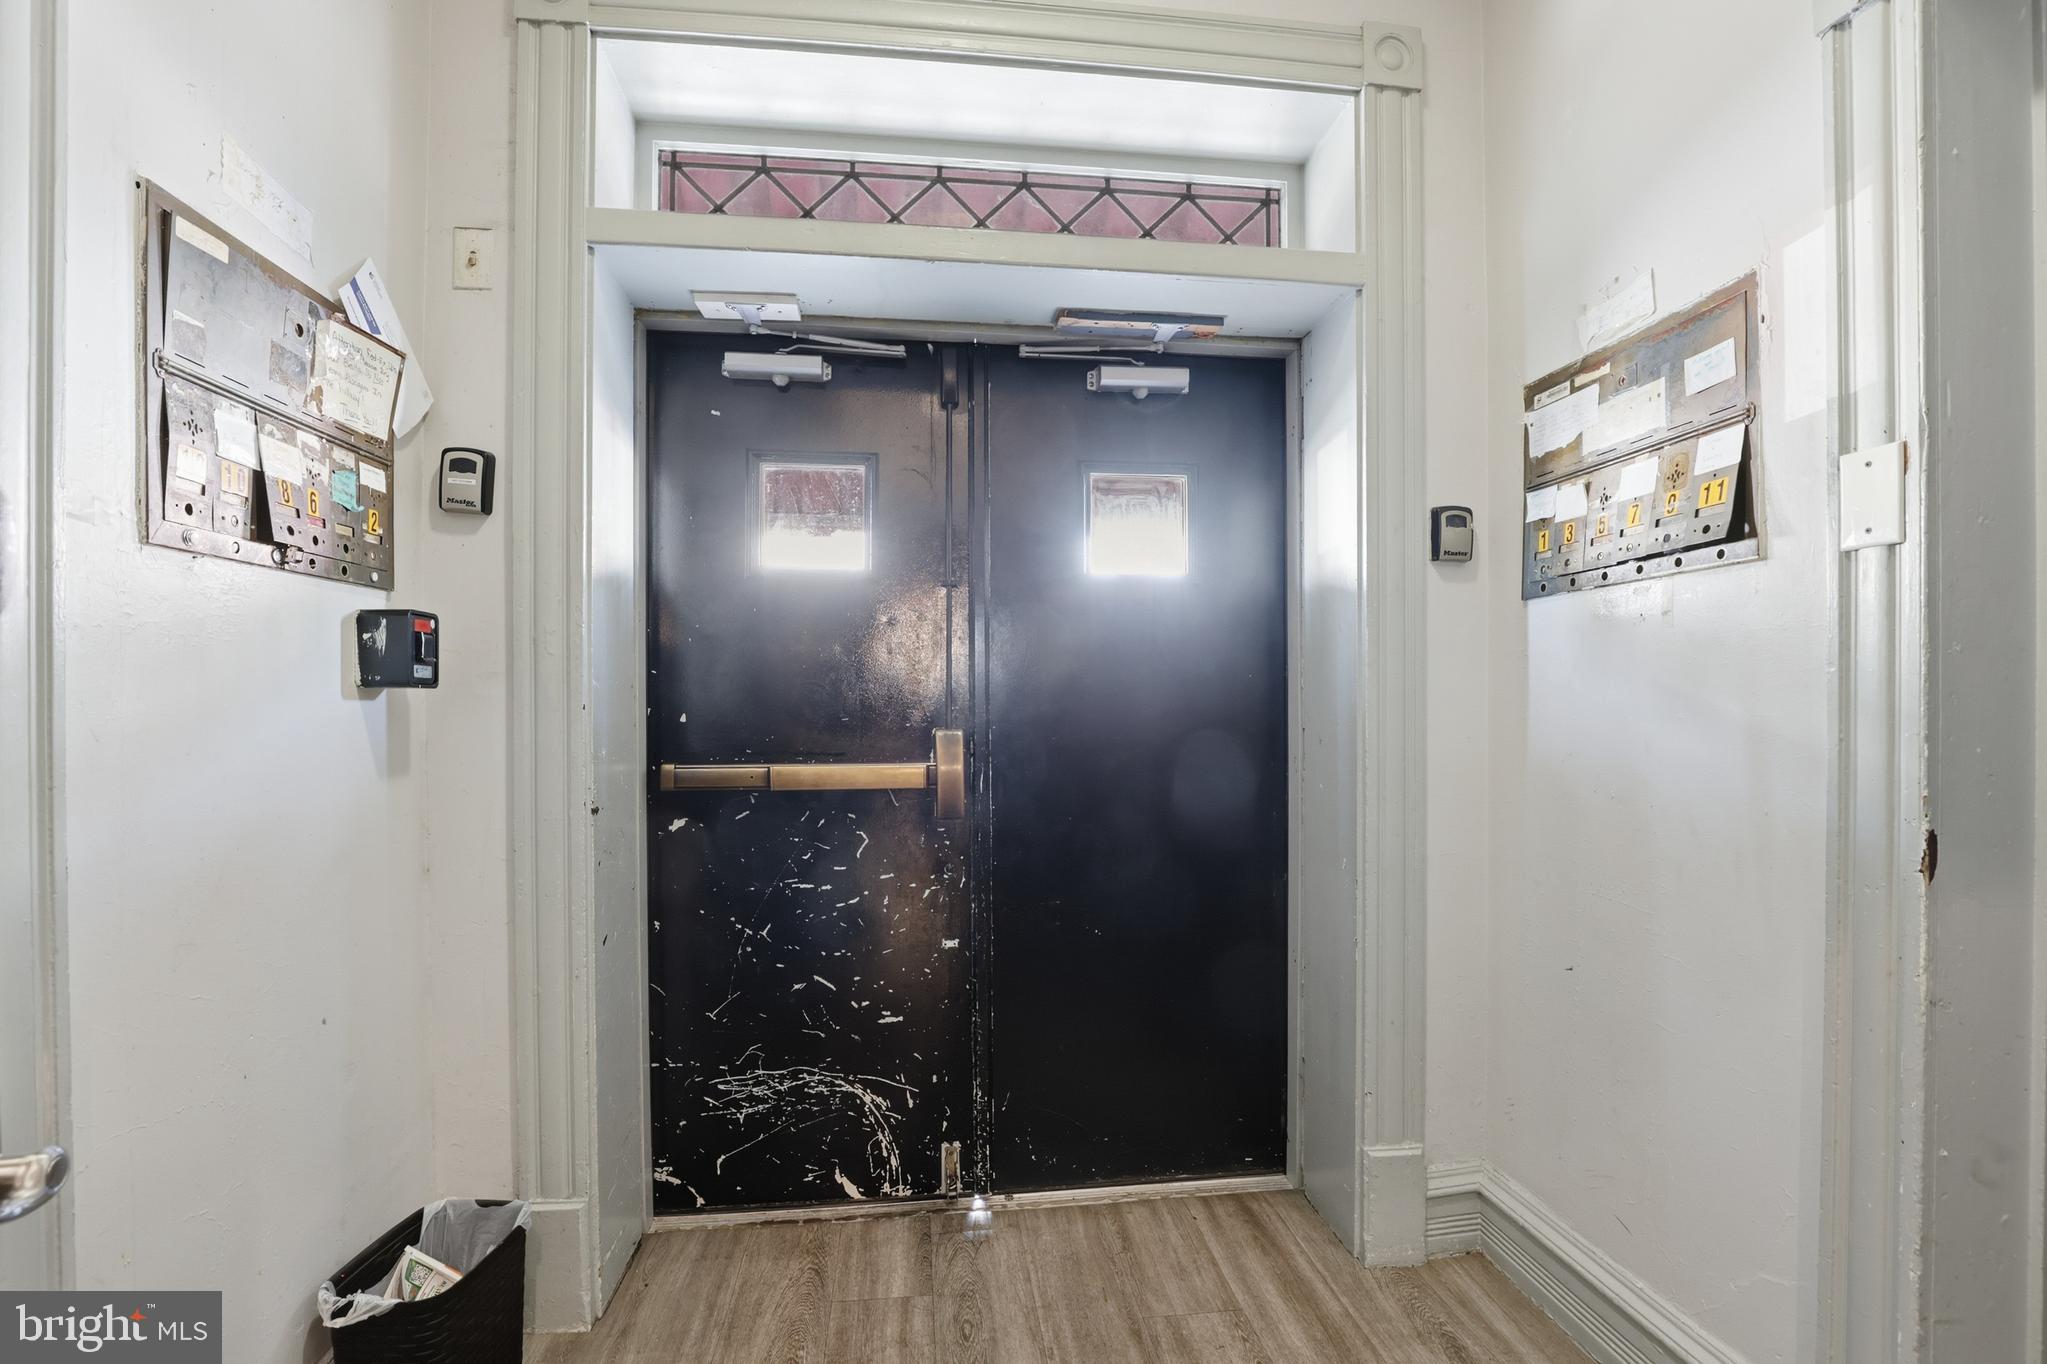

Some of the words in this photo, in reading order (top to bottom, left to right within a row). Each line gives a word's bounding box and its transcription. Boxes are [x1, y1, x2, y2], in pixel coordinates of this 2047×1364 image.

[281, 480, 290, 503] 8
[446, 497, 475, 505] Master
[1704, 479, 1725, 504] 11
[309, 491, 317, 514] 6
[1631, 502, 1640, 524] 7
[371, 511, 378, 532] 2
[1598, 515, 1606, 534] 5
[1541, 532, 1547, 550] 1
[1566, 524, 1574, 543] 3
